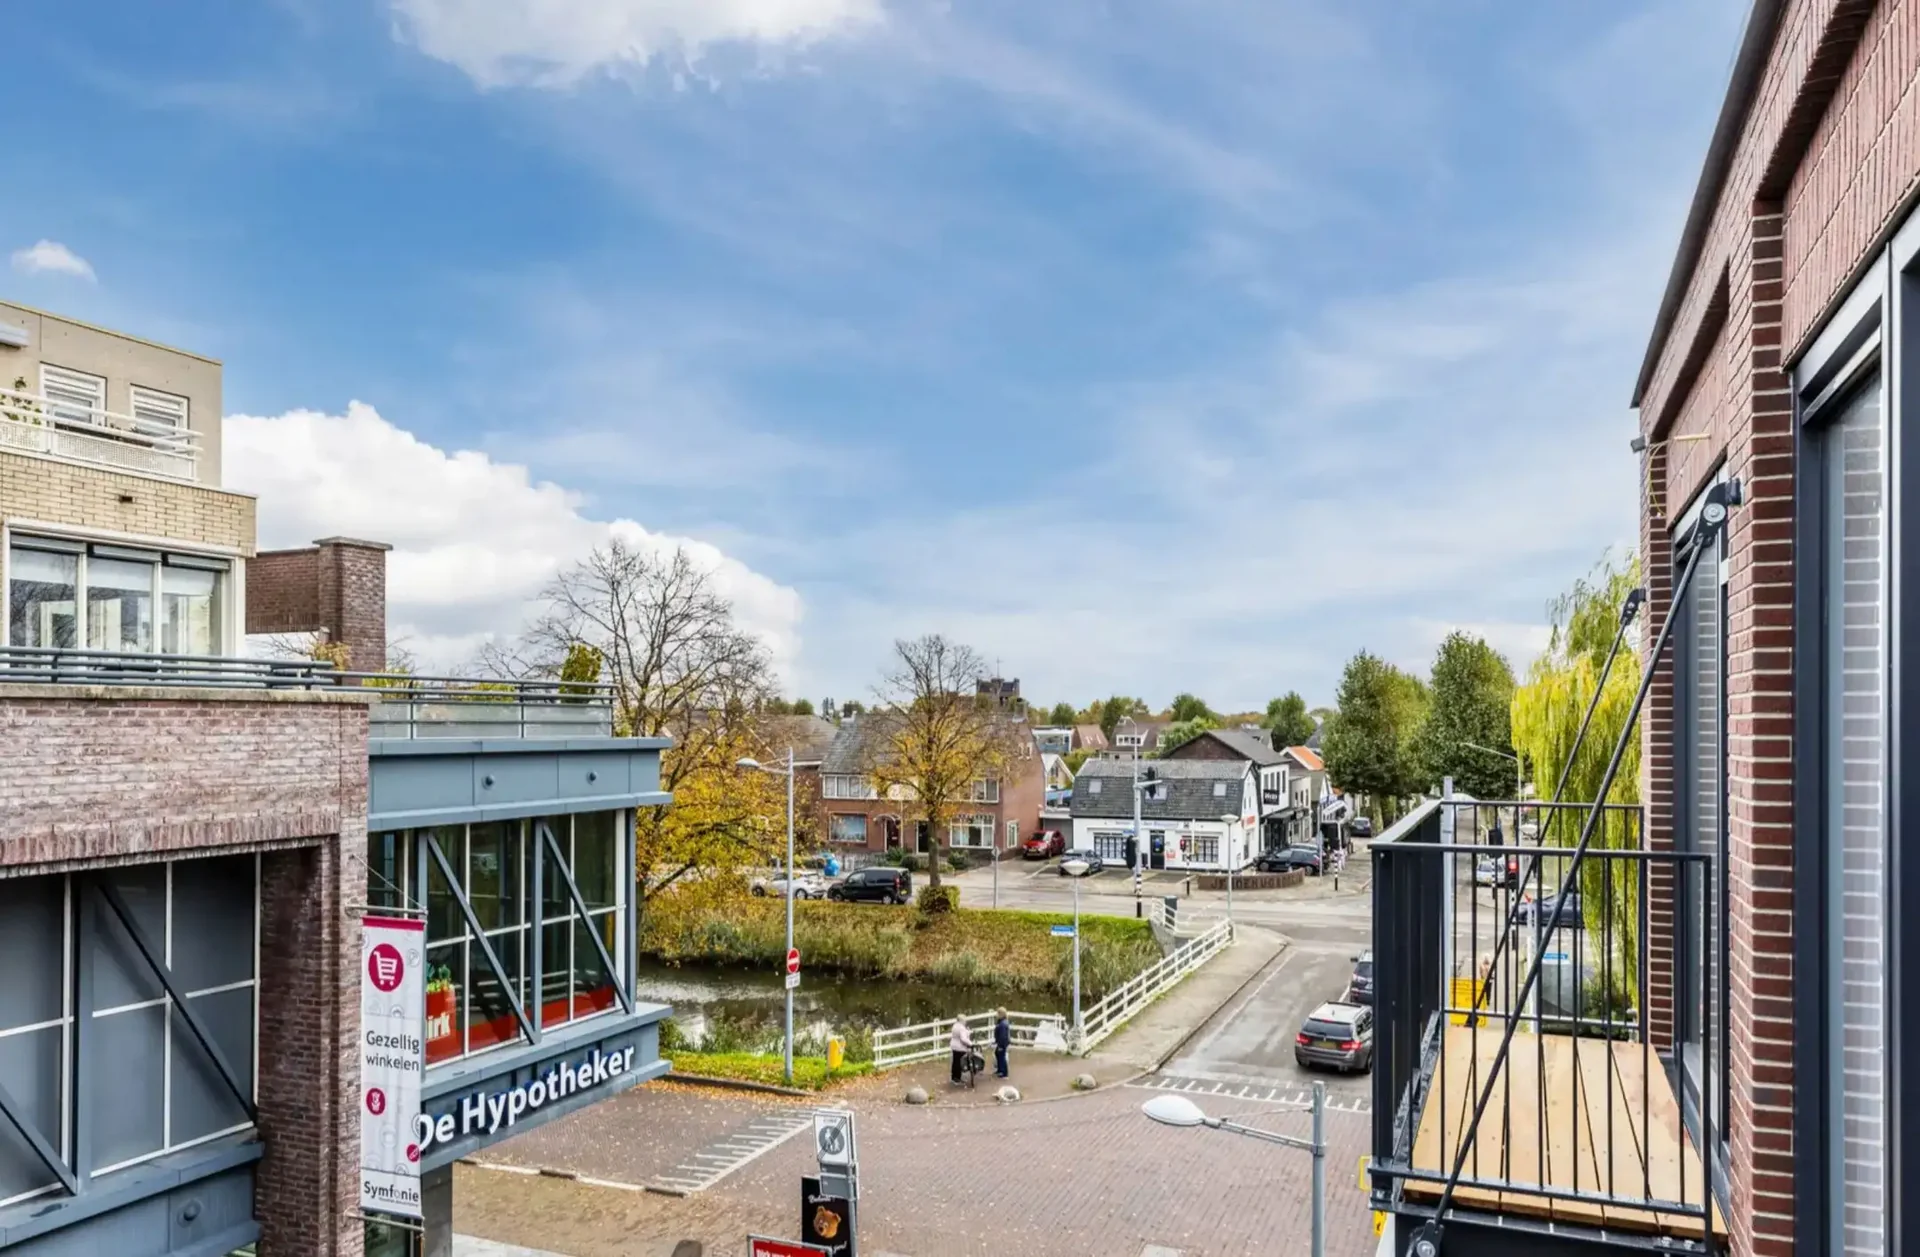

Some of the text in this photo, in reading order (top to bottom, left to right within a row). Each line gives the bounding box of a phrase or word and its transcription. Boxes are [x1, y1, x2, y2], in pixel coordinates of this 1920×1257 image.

[425, 1011, 451, 1043] irk
[366, 1030, 420, 1055] Gezellig
[366, 1053, 420, 1071] winkelen
[462, 1045, 635, 1135] Hypotheker
[364, 1180, 419, 1202] Symfonie
